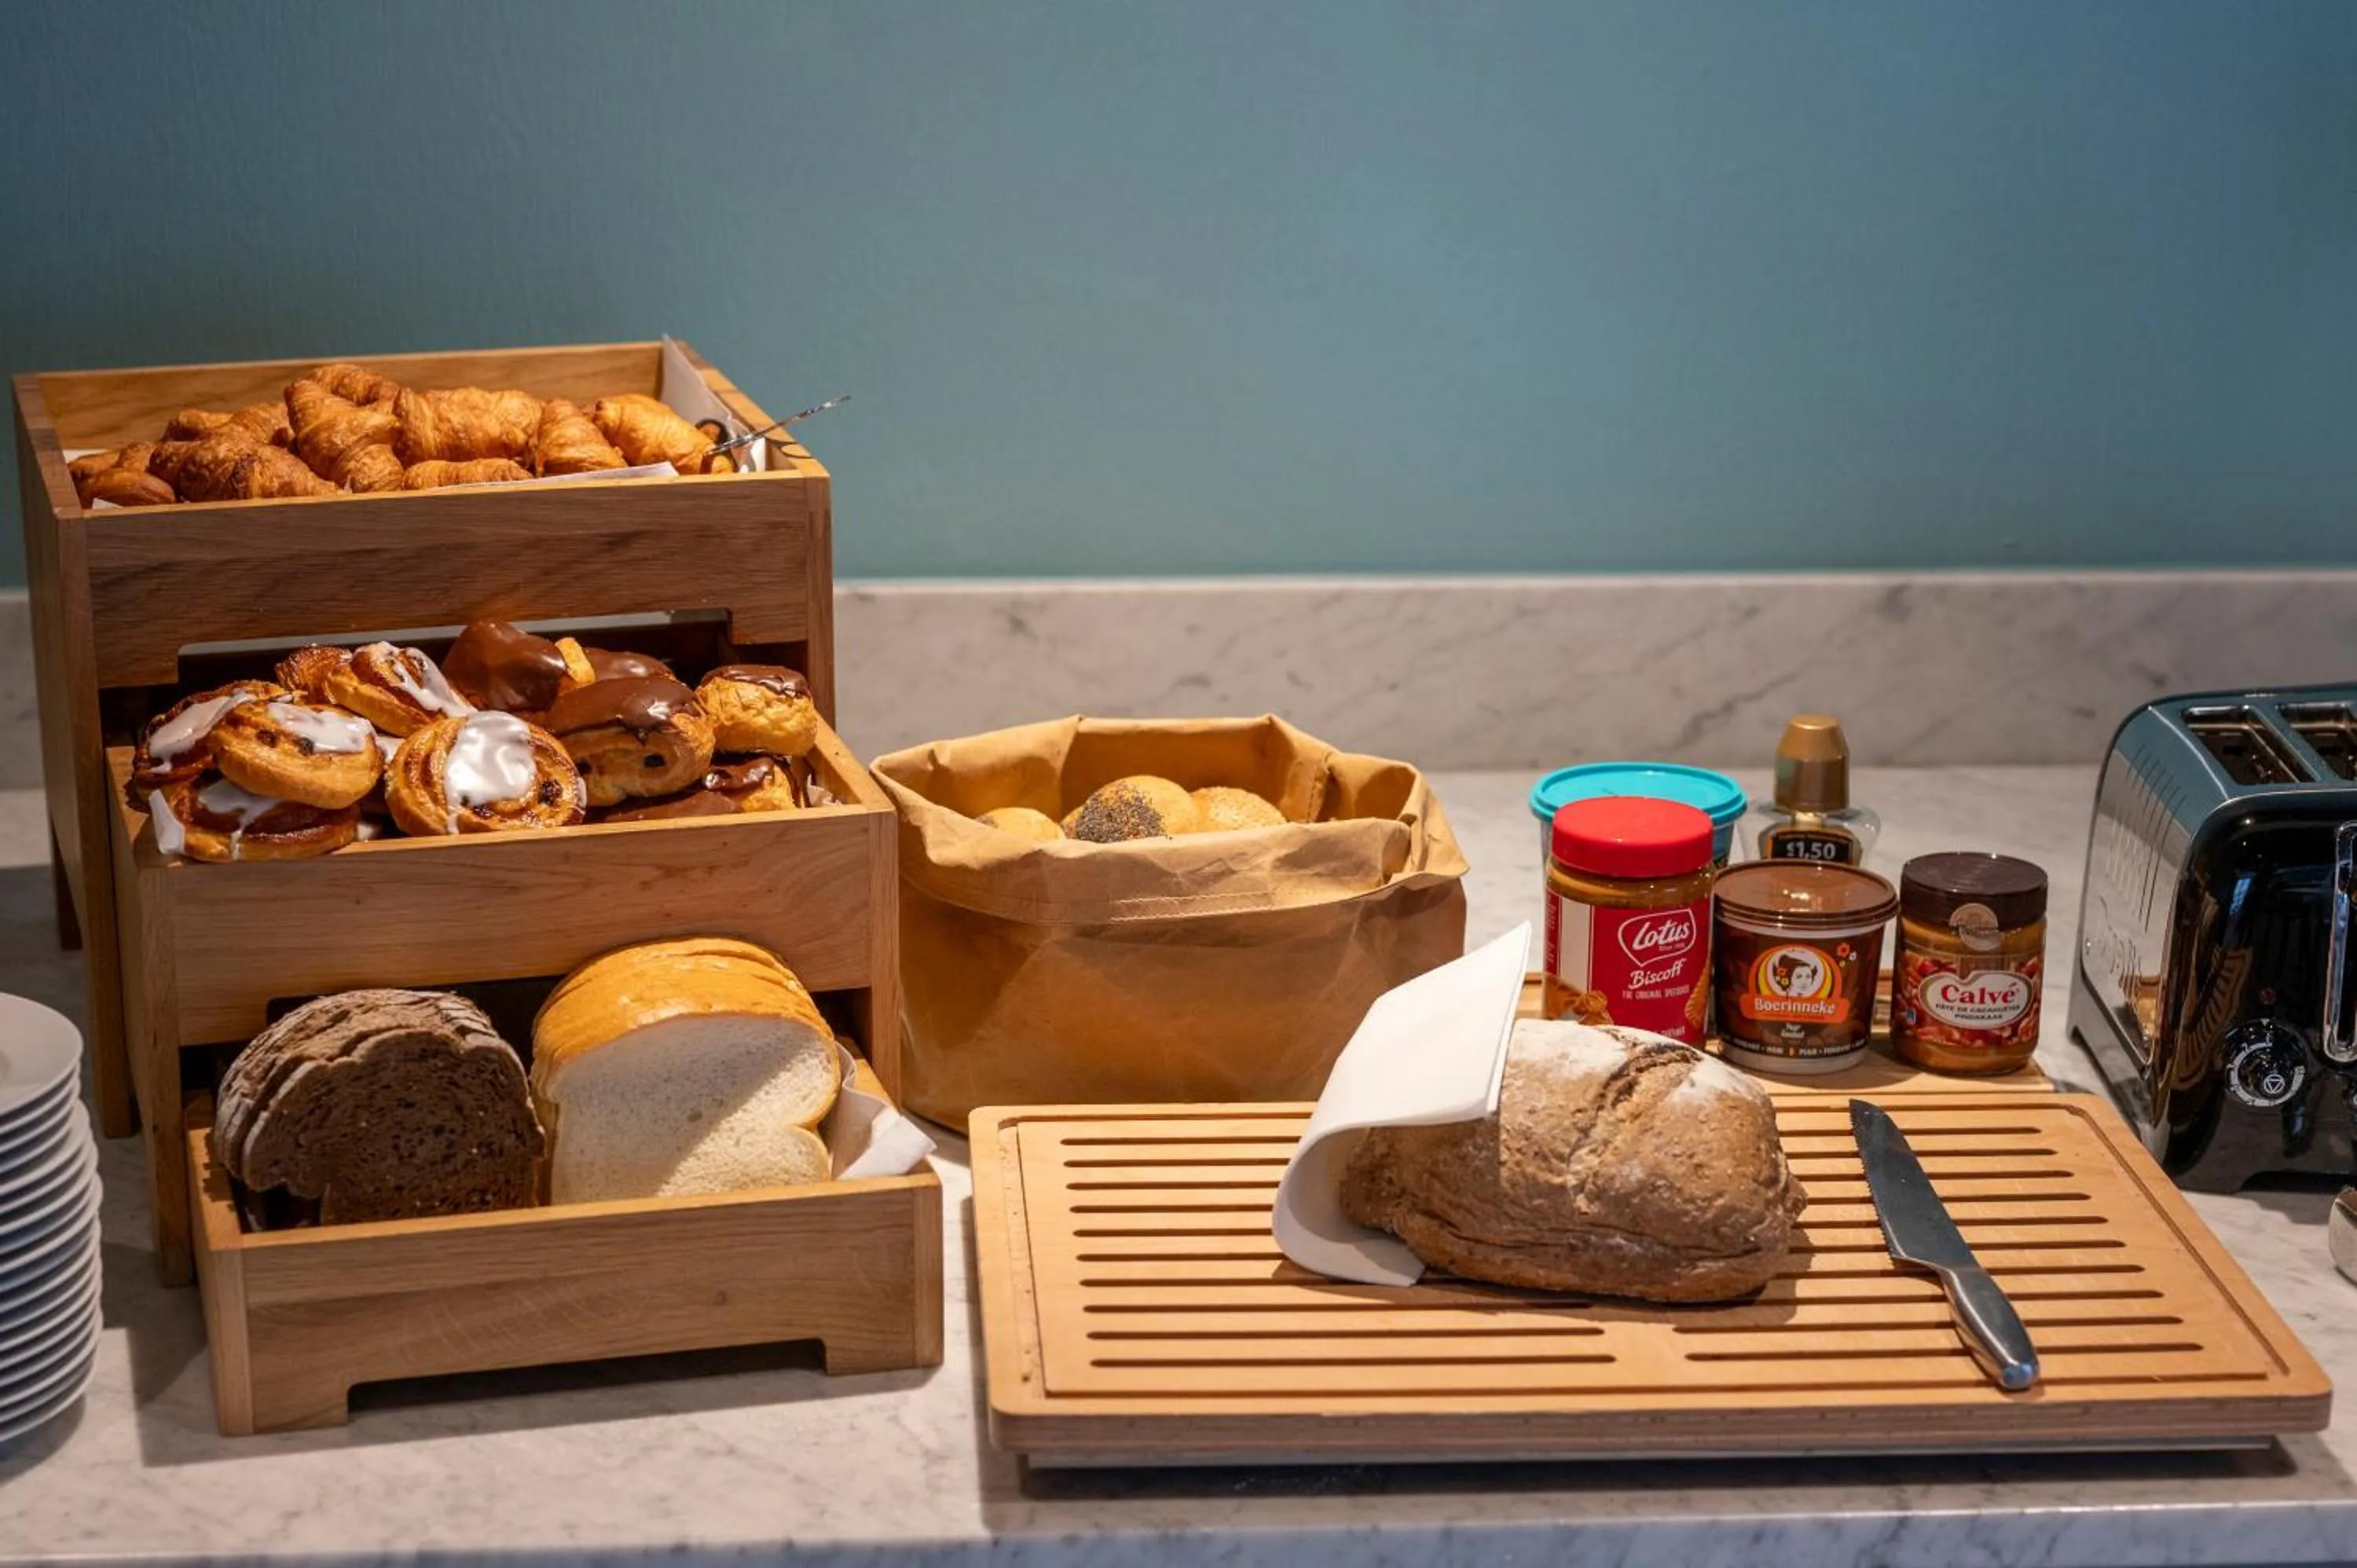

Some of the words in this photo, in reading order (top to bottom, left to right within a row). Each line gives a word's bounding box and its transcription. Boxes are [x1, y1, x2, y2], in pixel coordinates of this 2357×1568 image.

[1633, 918, 1690, 951] Lotus
[1627, 958, 1687, 990] Biscoff
[1754, 997, 1837, 1015] Boerinneke
[1941, 982, 2018, 1006] Calvé
